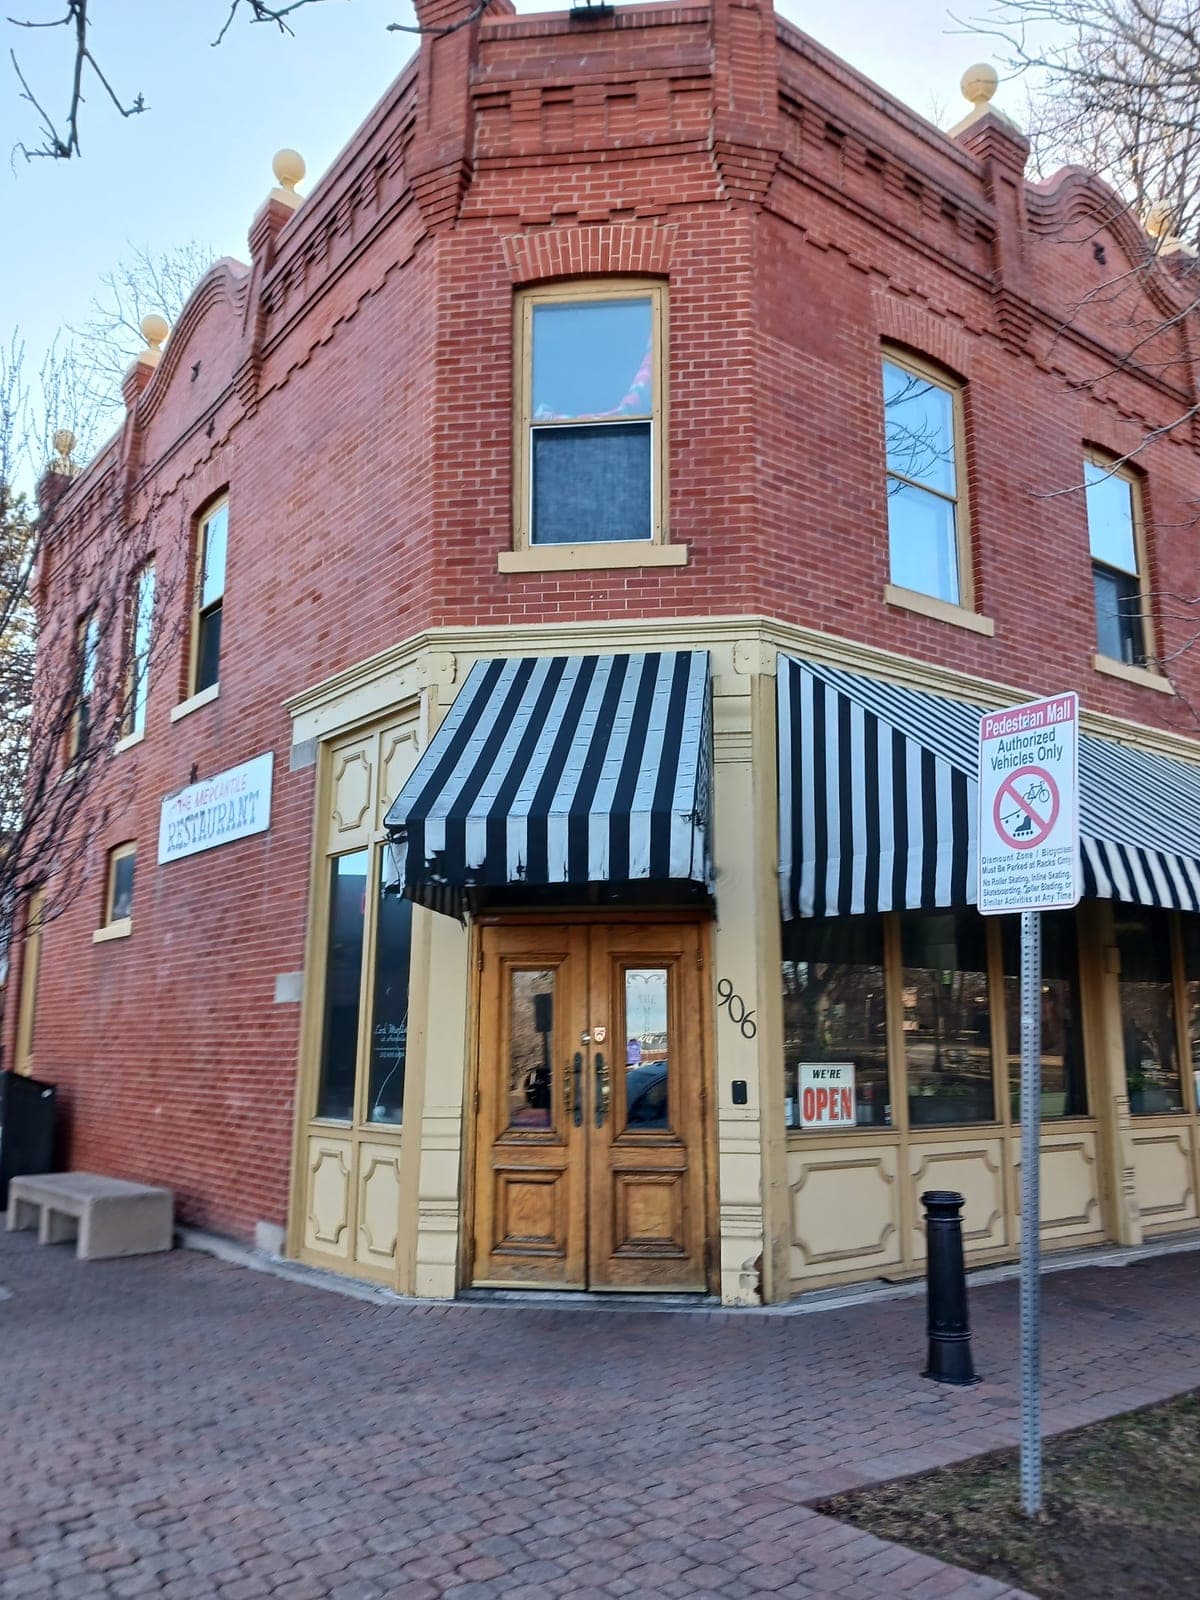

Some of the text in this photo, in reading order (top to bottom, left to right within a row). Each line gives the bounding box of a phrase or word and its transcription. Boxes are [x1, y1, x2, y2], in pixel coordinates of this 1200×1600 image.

[985, 700, 1071, 738] Pedestrian Mall
[997, 727, 1056, 754] Authorized
[991, 744, 1063, 771] Vehicles Only
[177, 773, 248, 814] THE MERCANTILE
[167, 790, 260, 852] RESTAURANT
[982, 854, 1014, 864] Dismount
[1016, 852, 1033, 860] Zone
[1006, 862, 1028, 872] Parked
[1037, 860, 1056, 868] Racks
[984, 898, 1003, 907] Similar
[1004, 896, 1032, 905] Activities
[1042, 894, 1054, 903] Any
[1056, 892, 1072, 900] Time
[718, 978, 756, 1039] 906
[812, 1069, 842, 1079] WE'RE
[803, 1086, 852, 1122] OPEN
